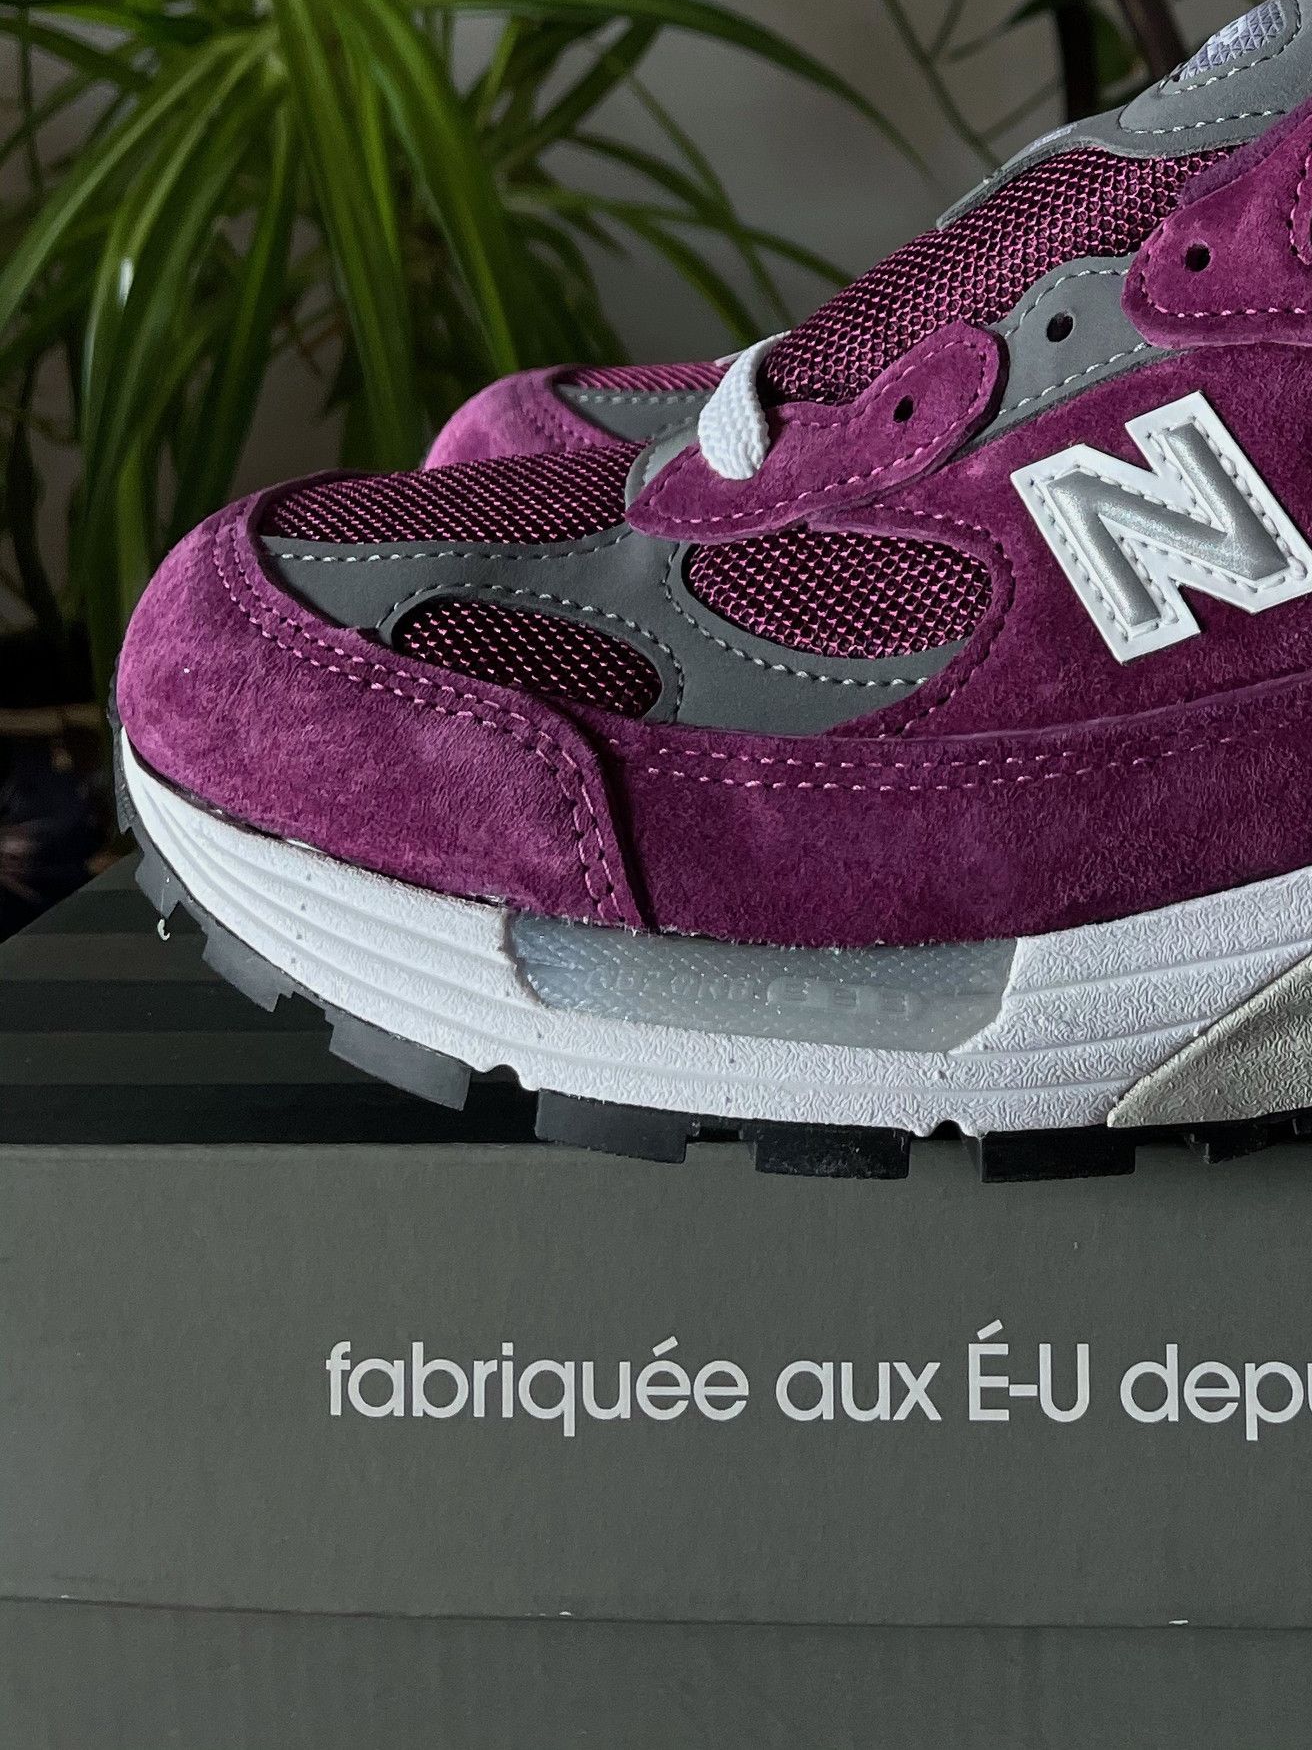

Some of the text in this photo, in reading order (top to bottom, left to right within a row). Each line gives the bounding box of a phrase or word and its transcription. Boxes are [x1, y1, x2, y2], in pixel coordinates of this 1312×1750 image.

[326, 1336, 749, 1437] fabriquée
[776, 1360, 942, 1422] aux
[969, 1320, 1089, 1422] É-U
